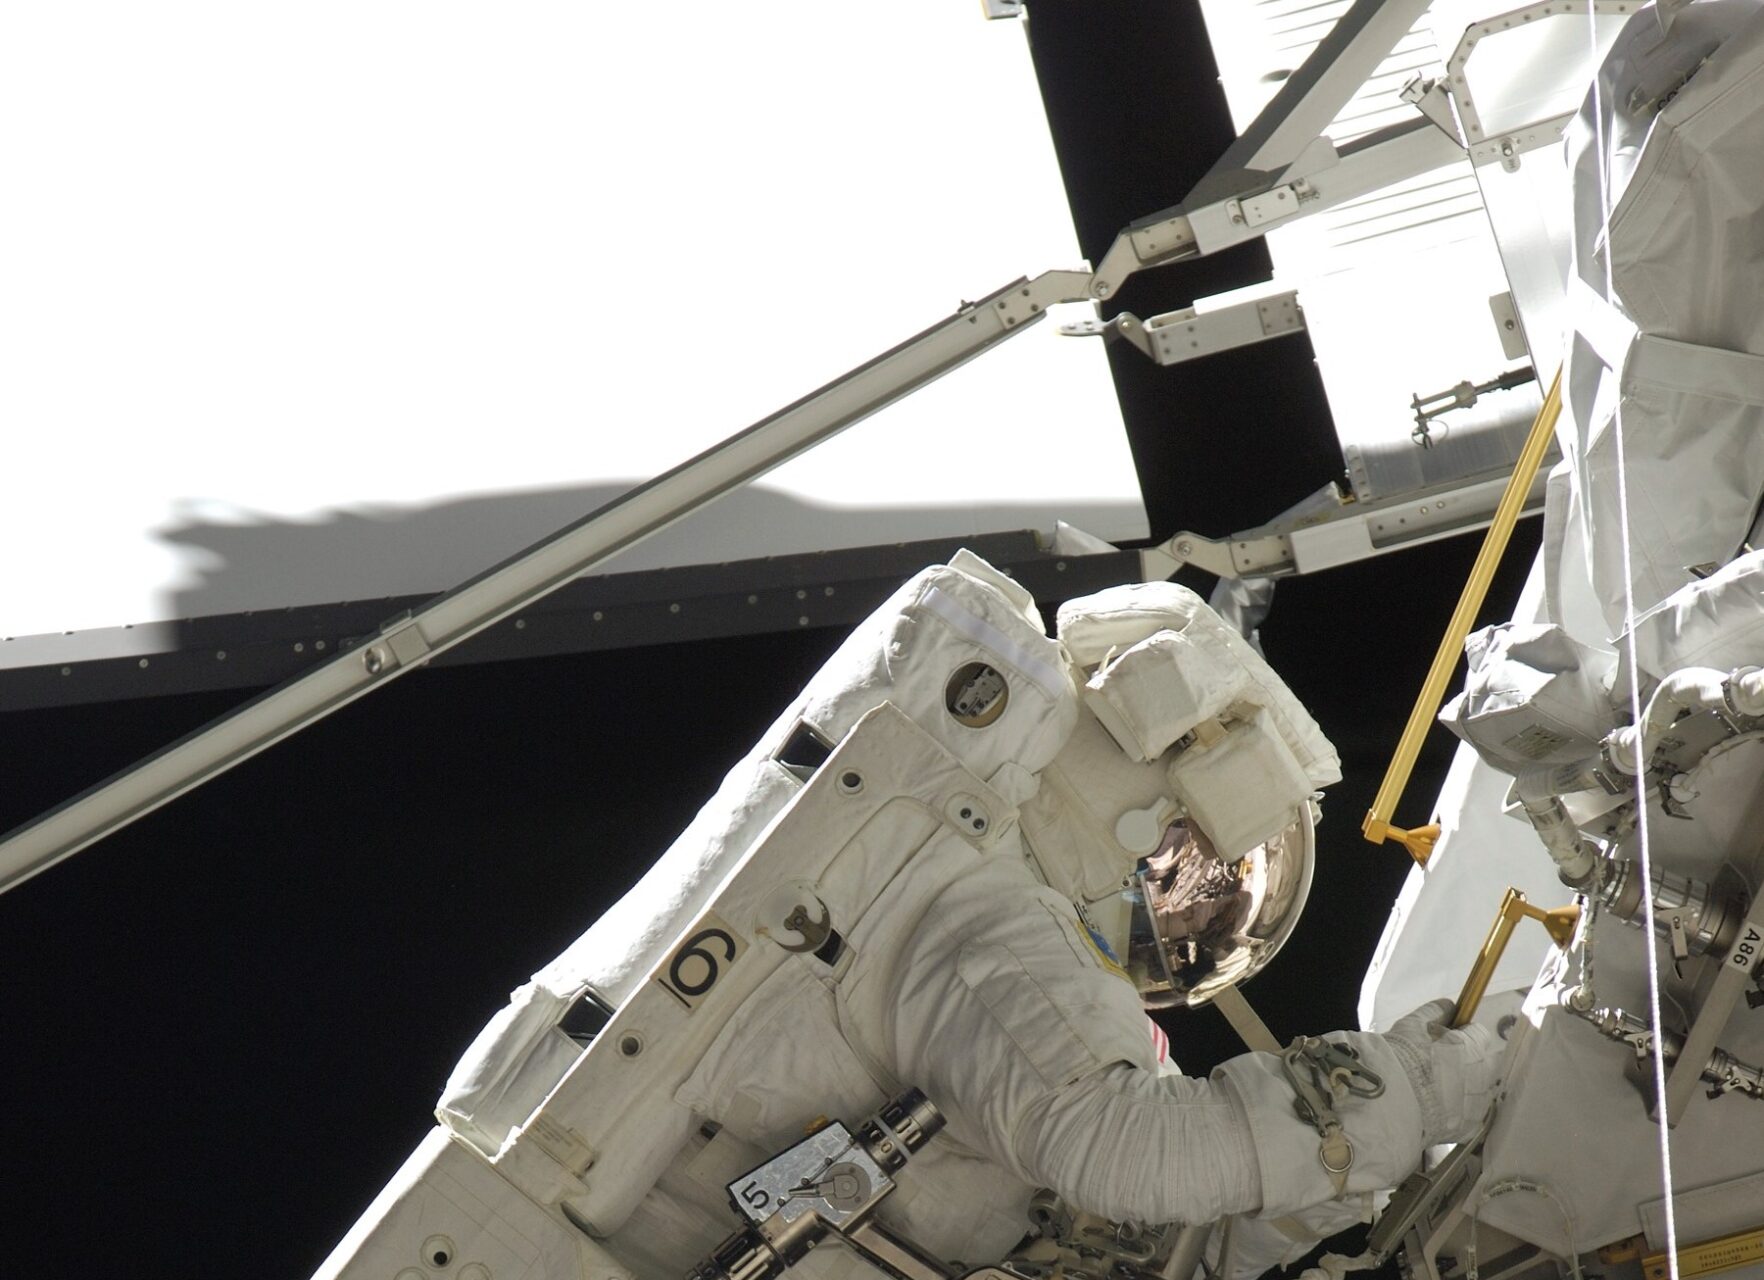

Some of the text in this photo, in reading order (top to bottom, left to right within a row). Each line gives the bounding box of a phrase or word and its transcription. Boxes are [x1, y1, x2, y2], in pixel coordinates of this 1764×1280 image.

[669, 928, 736, 997] 6
[1733, 928, 1761, 966] A86
[741, 1180, 769, 1209] 5
